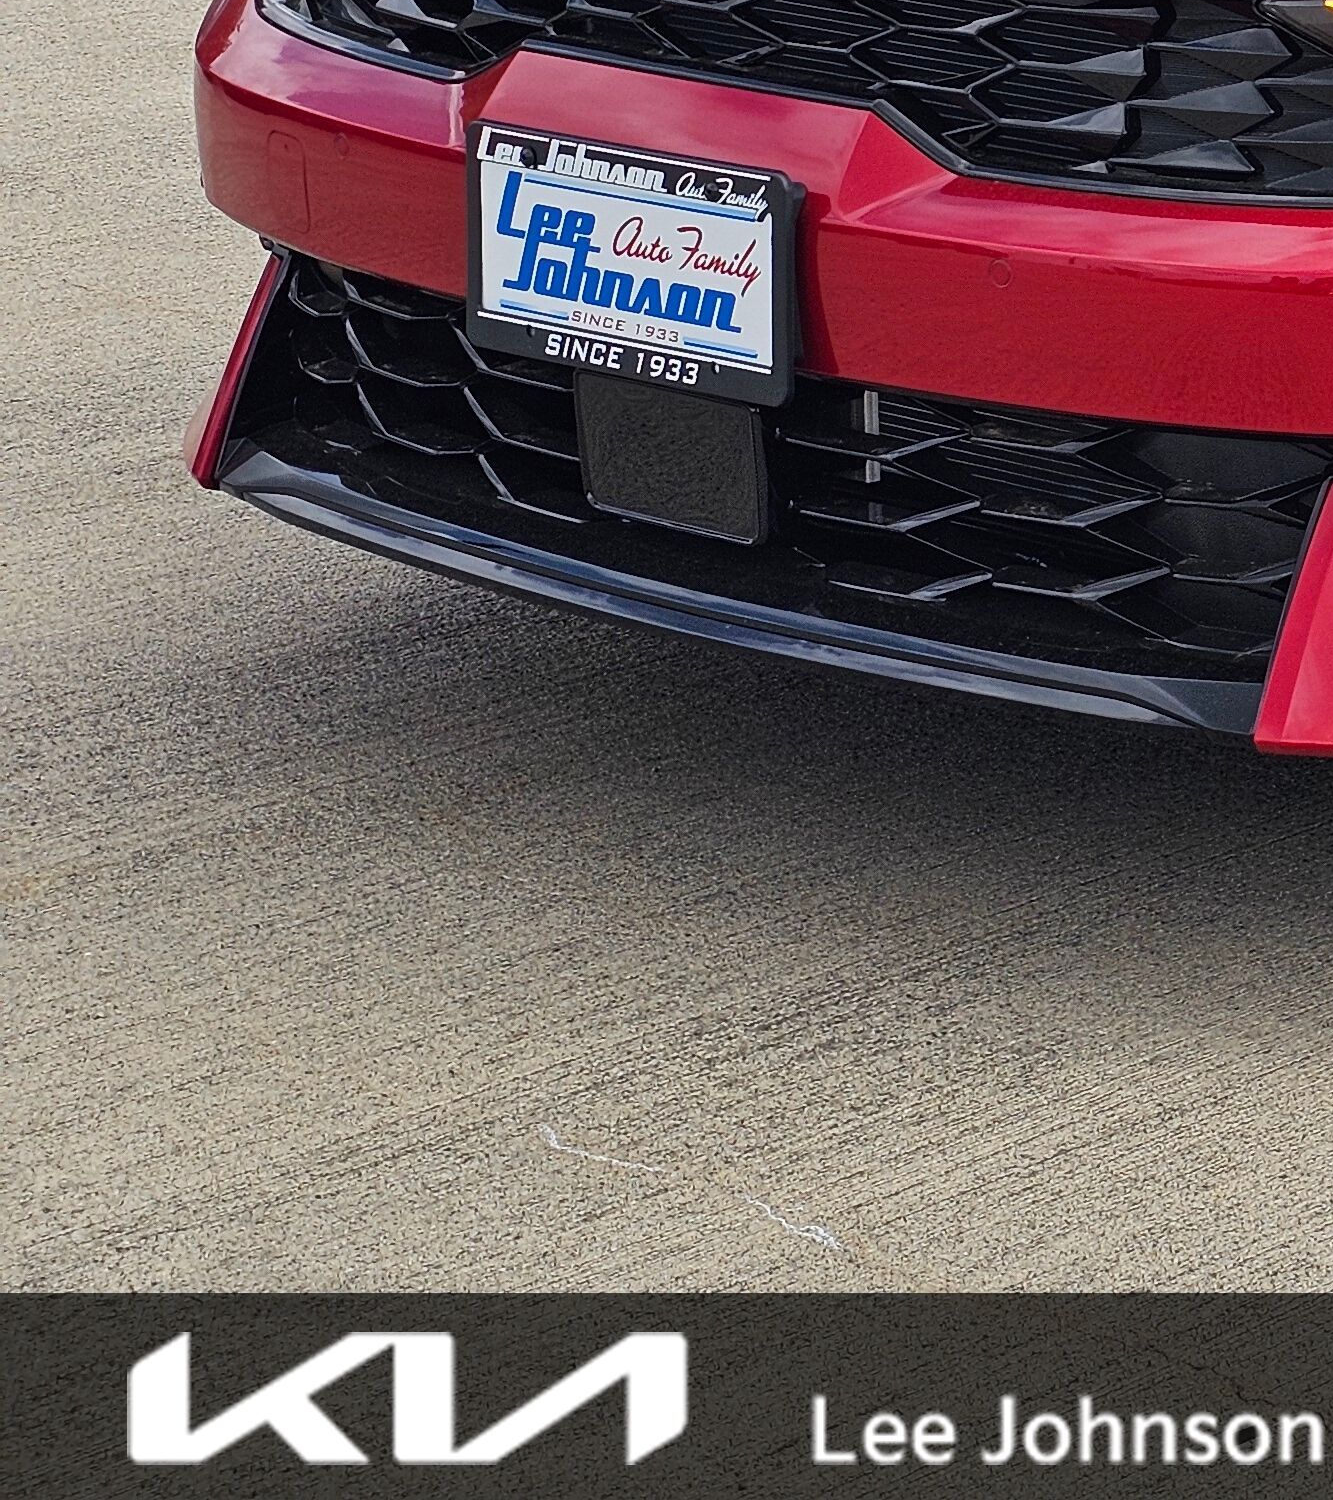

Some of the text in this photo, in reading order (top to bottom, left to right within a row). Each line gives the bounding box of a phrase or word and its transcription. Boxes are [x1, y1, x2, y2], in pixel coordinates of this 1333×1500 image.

[537, 138, 668, 193] Johnson
[676, 171, 708, 201] Aut
[716, 177, 769, 221] Family
[496, 171, 762, 298] Lee Auto Family
[502, 235, 742, 333] Johnson
[544, 333, 700, 386] SINCE 1933
[570, 310, 680, 343] SINCE 1933
